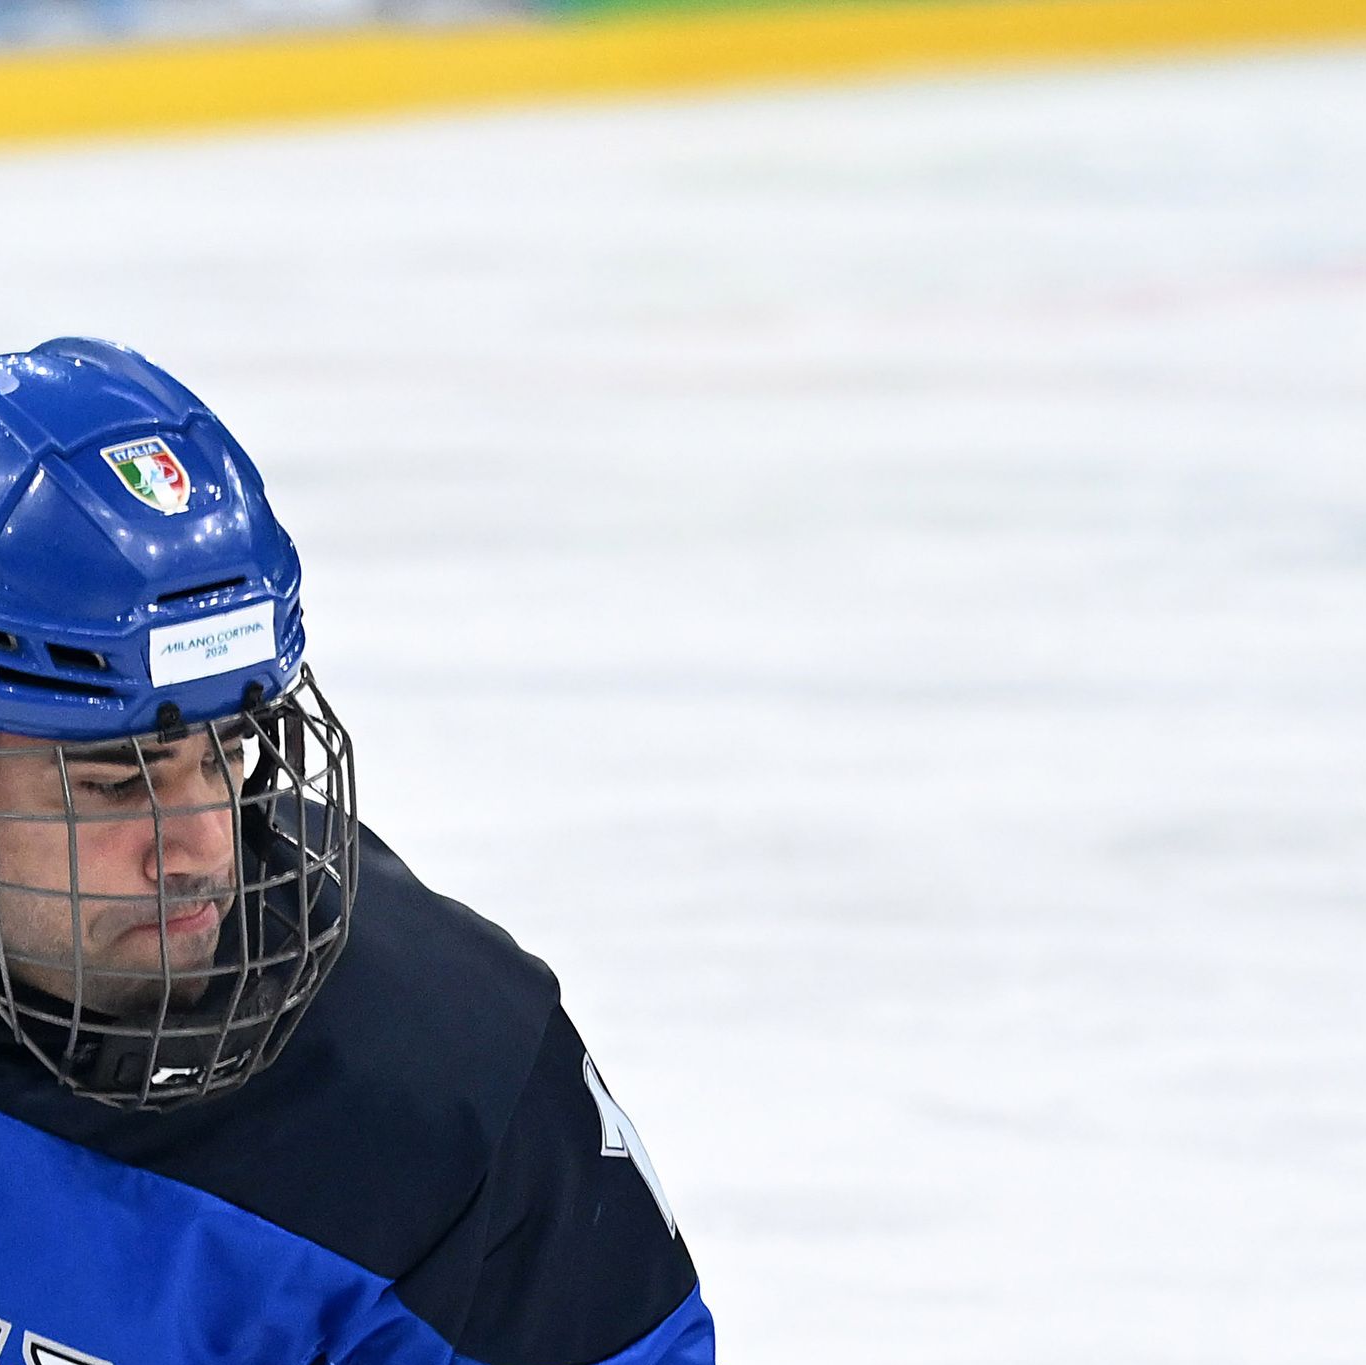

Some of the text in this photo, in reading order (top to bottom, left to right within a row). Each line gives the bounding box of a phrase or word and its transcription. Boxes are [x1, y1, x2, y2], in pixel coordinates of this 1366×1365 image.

[114, 442, 159, 461] ITALIA
[160, 622, 264, 656] MILANO CORTINA
[205, 645, 228, 659] 2026
